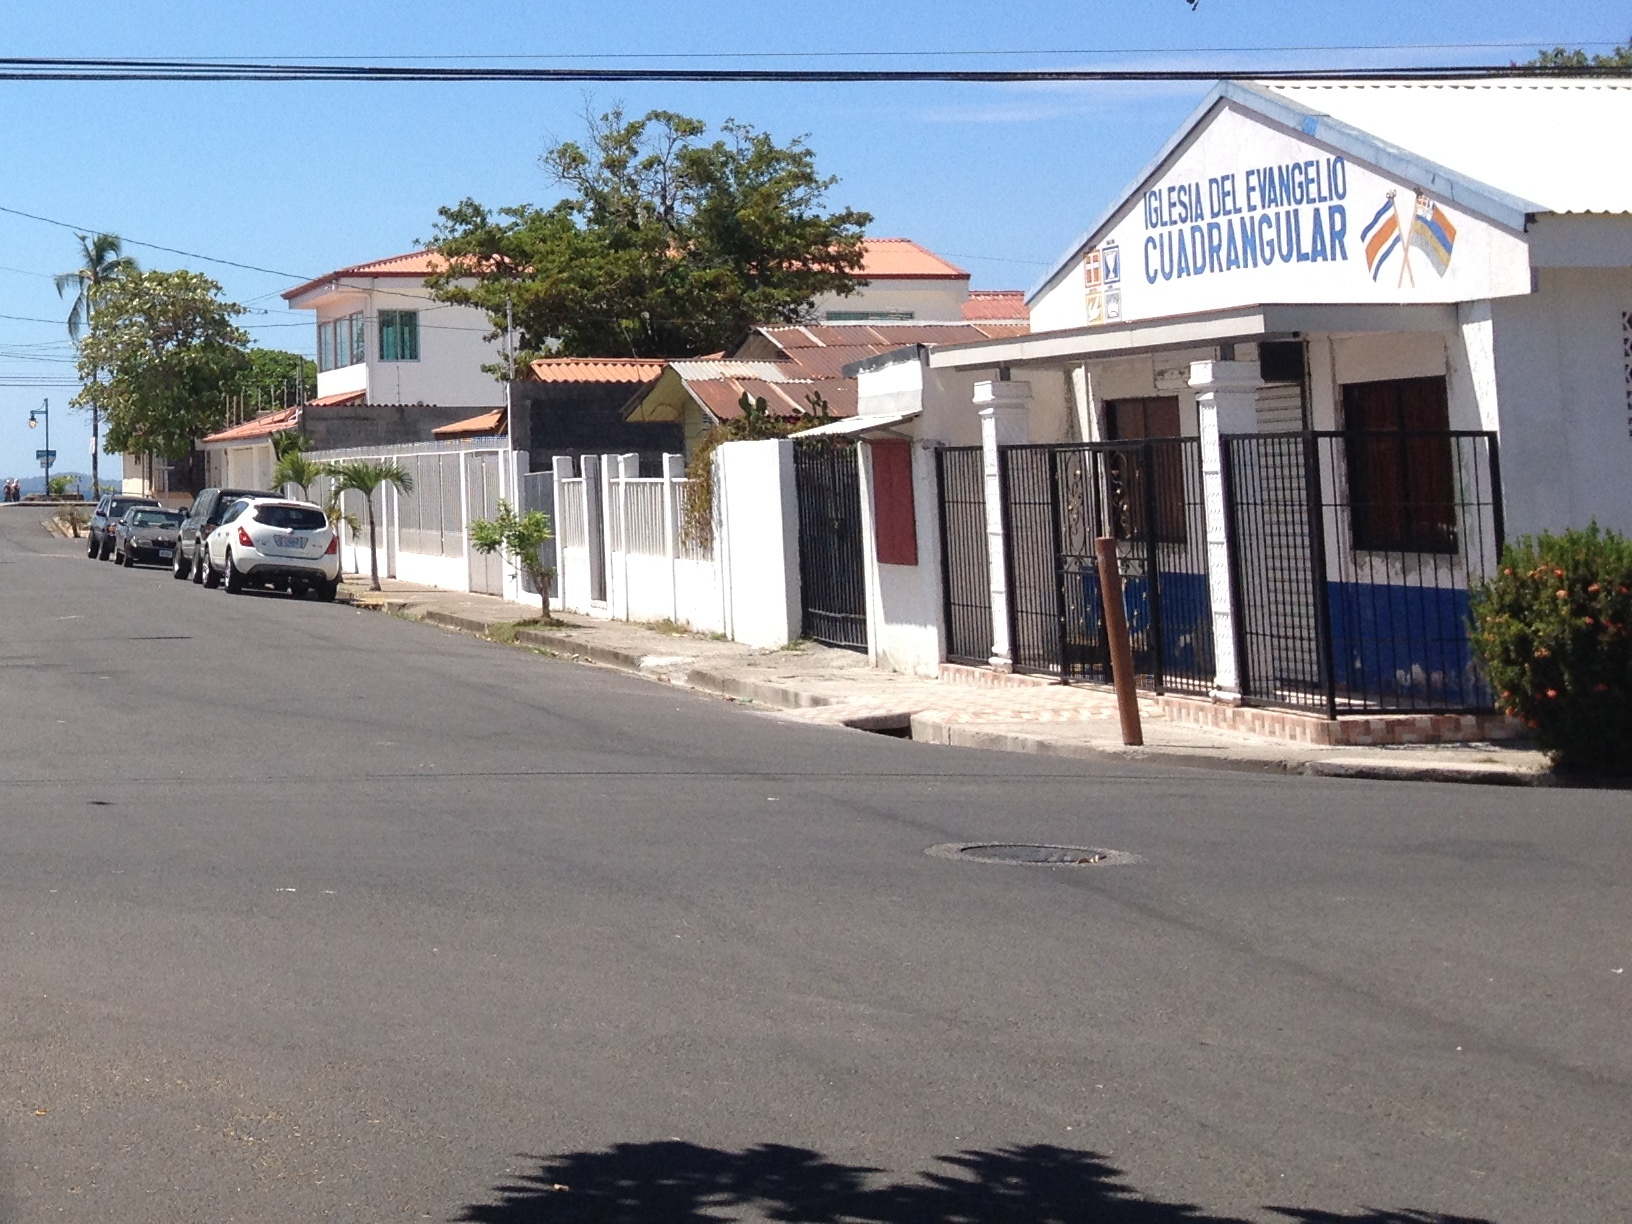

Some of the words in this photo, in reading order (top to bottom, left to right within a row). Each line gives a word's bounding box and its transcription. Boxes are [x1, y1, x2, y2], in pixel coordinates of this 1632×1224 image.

[1144, 182, 1204, 230] IGLESIA
[1208, 174, 1242, 219] DEL
[1245, 156, 1347, 213] EVANGELIO
[1144, 204, 1349, 285] CUADRANGULAR
